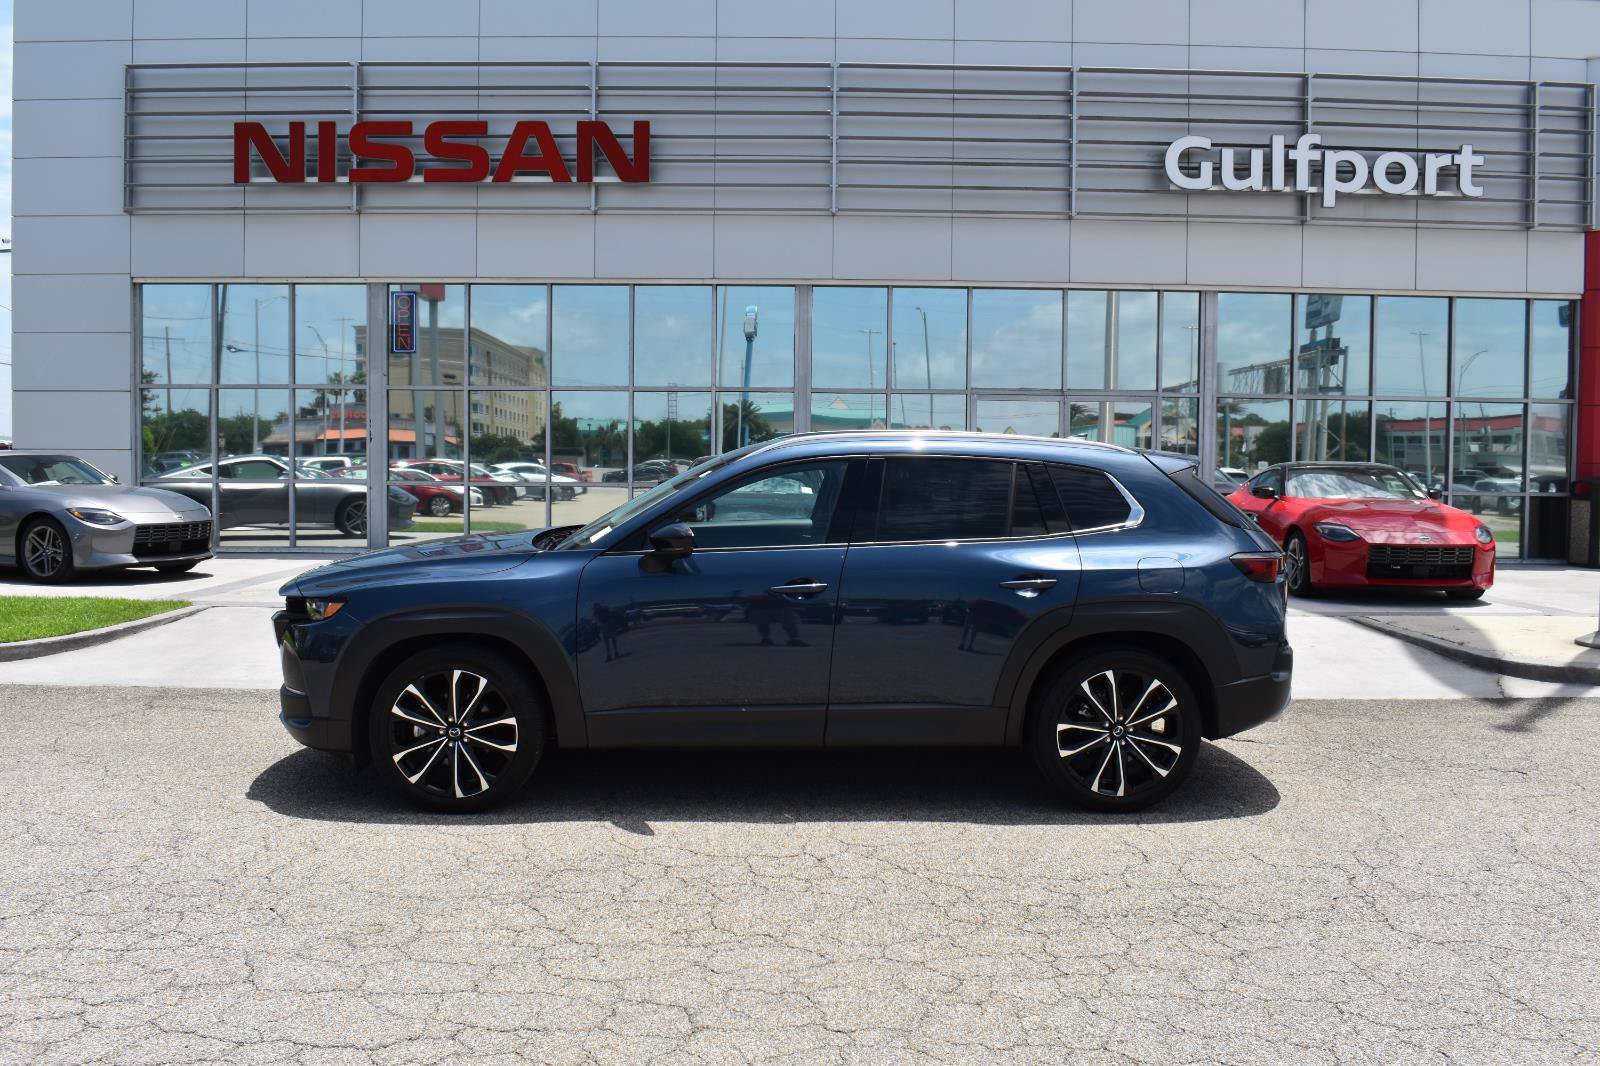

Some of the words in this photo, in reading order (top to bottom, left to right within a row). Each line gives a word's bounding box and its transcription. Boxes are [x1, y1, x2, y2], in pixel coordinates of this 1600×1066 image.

[234, 120, 650, 183] NISSAN
[1164, 133, 1485, 208] Gulfport
[397, 295, 411, 349] OPEN
